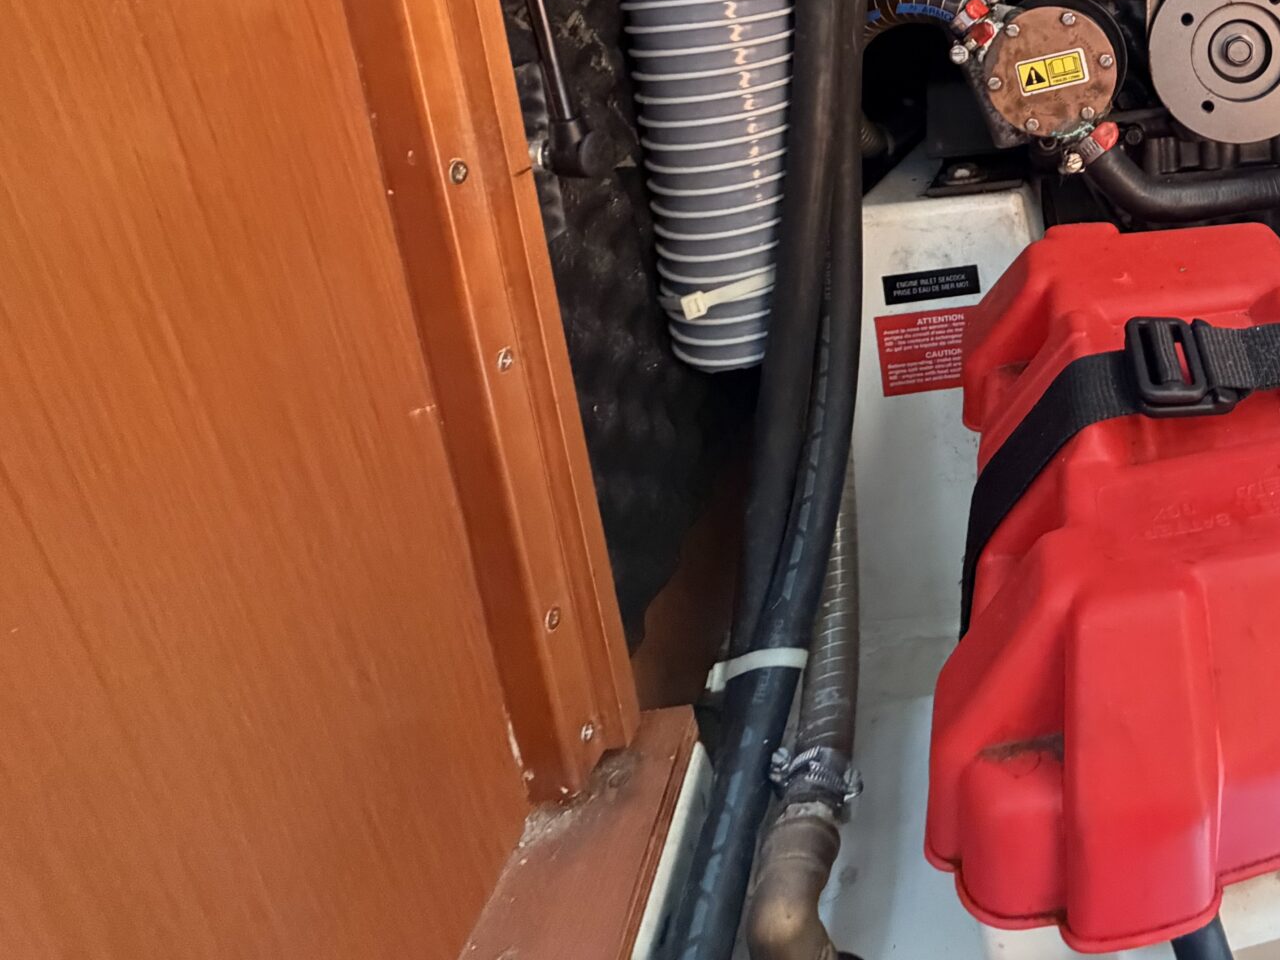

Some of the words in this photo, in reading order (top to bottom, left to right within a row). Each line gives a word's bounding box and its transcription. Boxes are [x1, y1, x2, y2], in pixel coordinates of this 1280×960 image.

[896, 279, 918, 289] ENGINE
[920, 278, 937, 286] INLET
[893, 289, 911, 297] PRISE
[917, 314, 965, 325] ATTENTION
